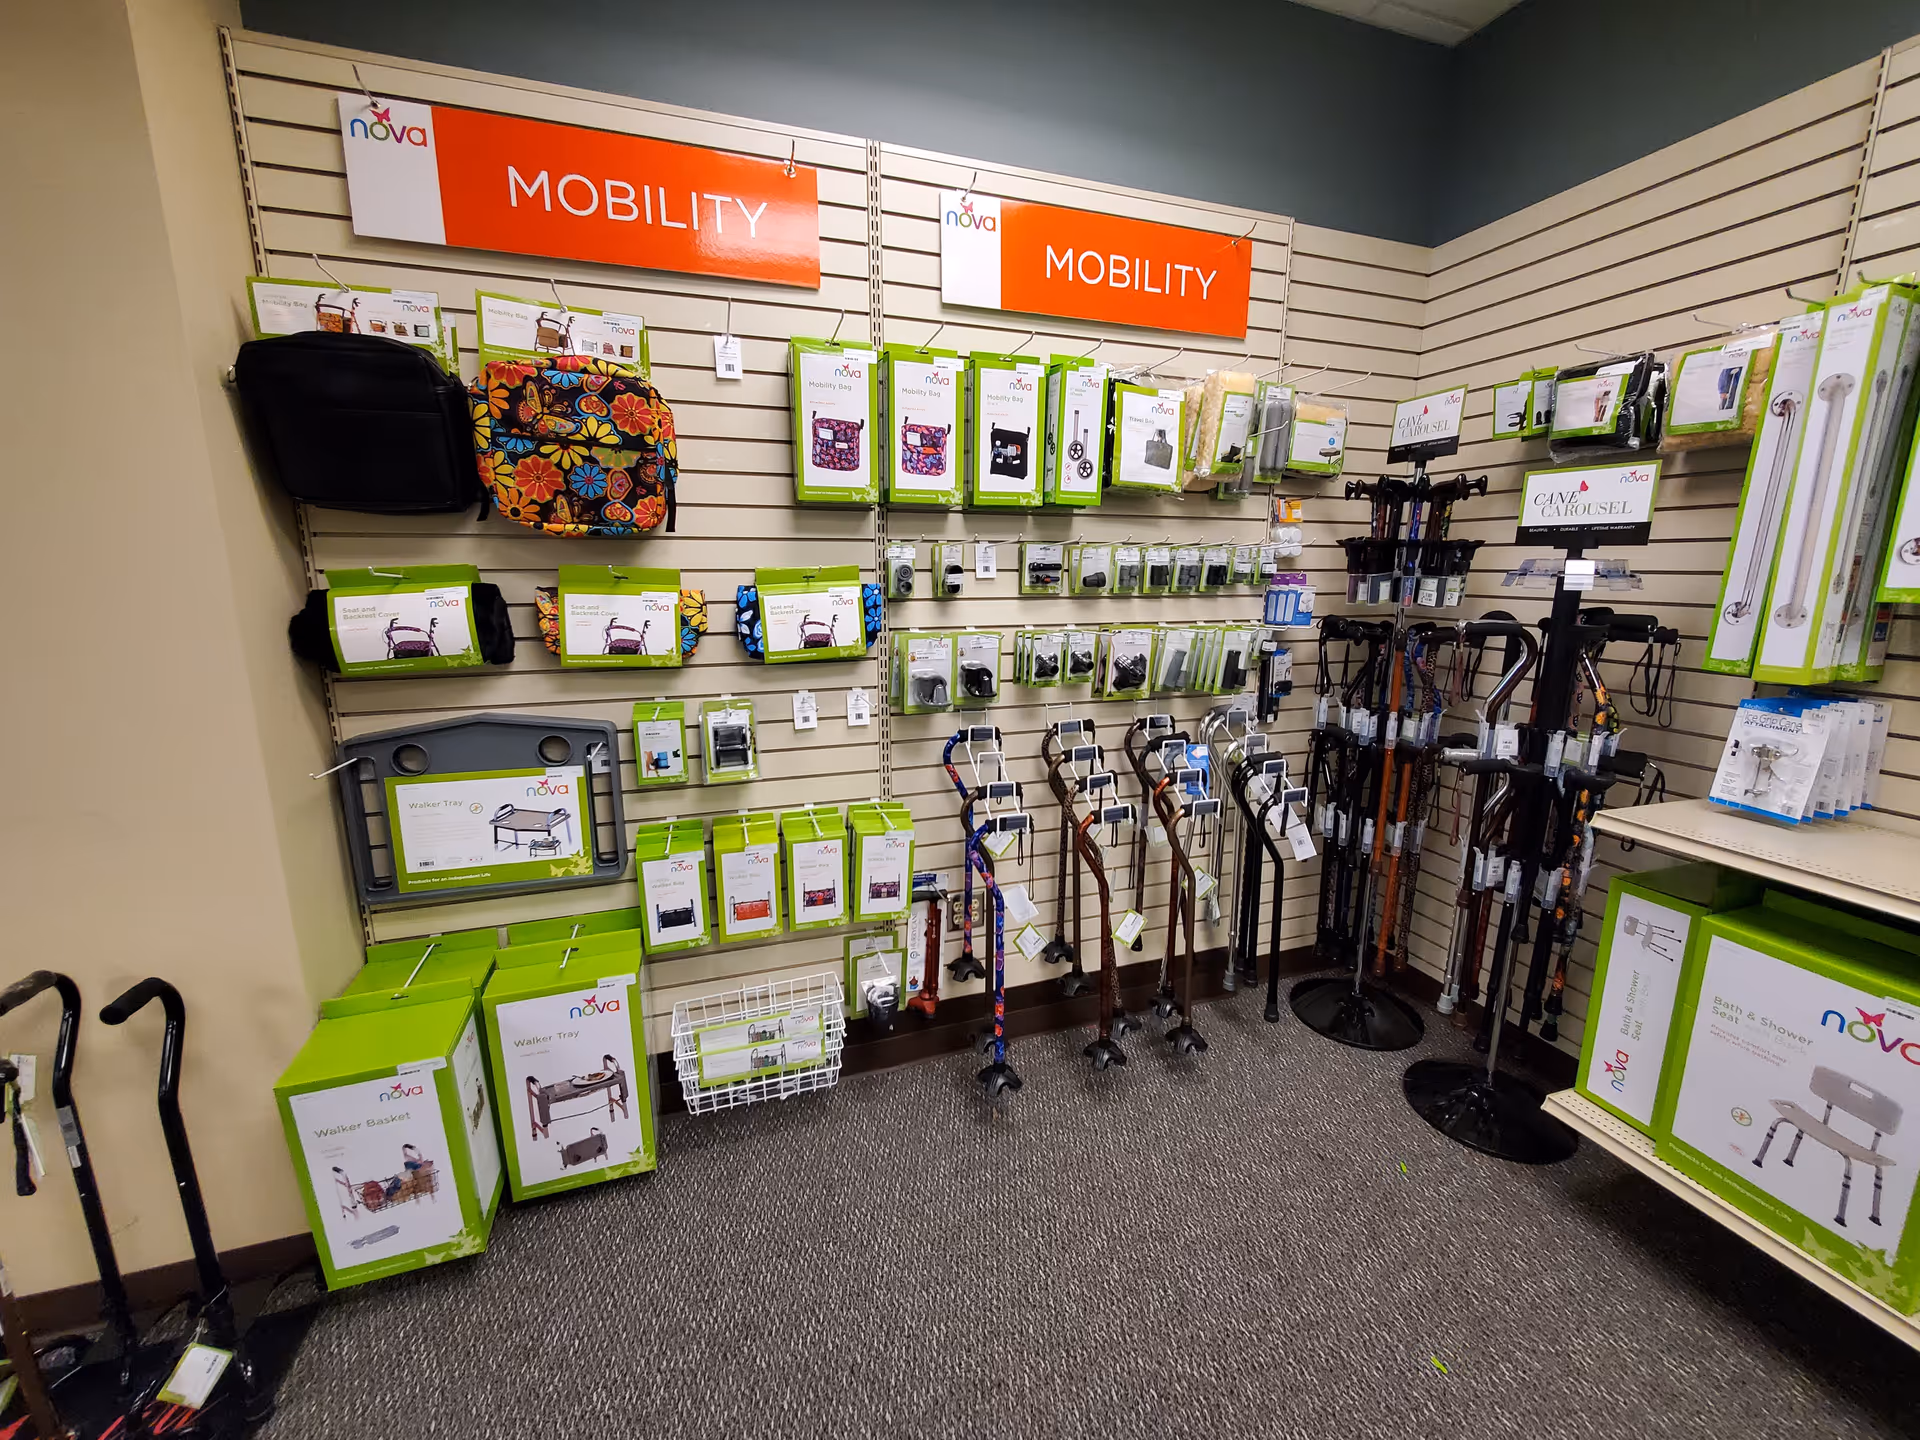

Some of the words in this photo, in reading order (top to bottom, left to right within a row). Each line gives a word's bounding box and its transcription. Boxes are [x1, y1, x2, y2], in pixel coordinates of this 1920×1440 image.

[350, 117, 428, 148] nova
[507, 165, 768, 239] MOBILITY
[946, 210, 997, 232] nova
[1045, 244, 1217, 300] MOBILITY
[403, 304, 430, 313] nova
[488, 307, 514, 319] Mobility
[515, 312, 528, 321] Bag
[1837, 307, 1873, 322] nova
[611, 326, 635, 336] nova
[1790, 330, 1821, 343] nova
[834, 368, 862, 379] nova
[808, 381, 837, 391] Mobility
[838, 383, 852, 391] Bag
[925, 375, 950, 386] nova
[1009, 381, 1033, 391] nova
[1082, 380, 1100, 389] nova
[901, 387, 927, 397] Mobility
[928, 389, 941, 398] Bag
[987, 394, 1010, 403] Mobility
[1012, 396, 1024, 404] Bag
[1151, 405, 1175, 416] nova
[1398, 413, 1425, 430] CANE
[1401, 419, 1450, 438] CAROUSEL
[1619, 474, 1649, 484] nova
[1533, 490, 1581, 507] CANE
[1541, 500, 1633, 518] CAROUSEL
[429, 599, 459, 608] nova
[644, 603, 670, 612] nova
[832, 598, 854, 606] nova
[343, 612, 377, 620] Backrest
[378, 611, 400, 619] Cover
[1744, 710, 1758, 721] Ice
[1760, 714, 1778, 725] Grip
[1779, 717, 1803, 728] Cane
[1743, 720, 1801, 734] ATTACHMENT
[526, 784, 569, 797] nova
[409, 801, 440, 810] Walker
[442, 799, 463, 808] Tray
[817, 846, 838, 855] nova
[885, 841, 905, 849] nova
[747, 856, 769, 865] nova
[670, 863, 693, 873] nova
[1626, 970, 1640, 1004] Shower
[569, 999, 621, 1019] nova
[1624, 1005, 1633, 1013] &
[1712, 1006, 1740, 1025] Seat
[1620, 1013, 1632, 1036] Bath
[1713, 995, 1743, 1016] Bath
[1746, 1011, 1756, 1021] &
[1760, 1016, 1814, 1046] Shower
[1631, 1020, 1643, 1042] Seat
[514, 1034, 553, 1048] Walker
[557, 1029, 580, 1041] Tray
[1610, 1049, 1630, 1093] nova
[379, 1084, 424, 1102] nova
[314, 1121, 362, 1139] Walker
[366, 1111, 412, 1128] Basket
